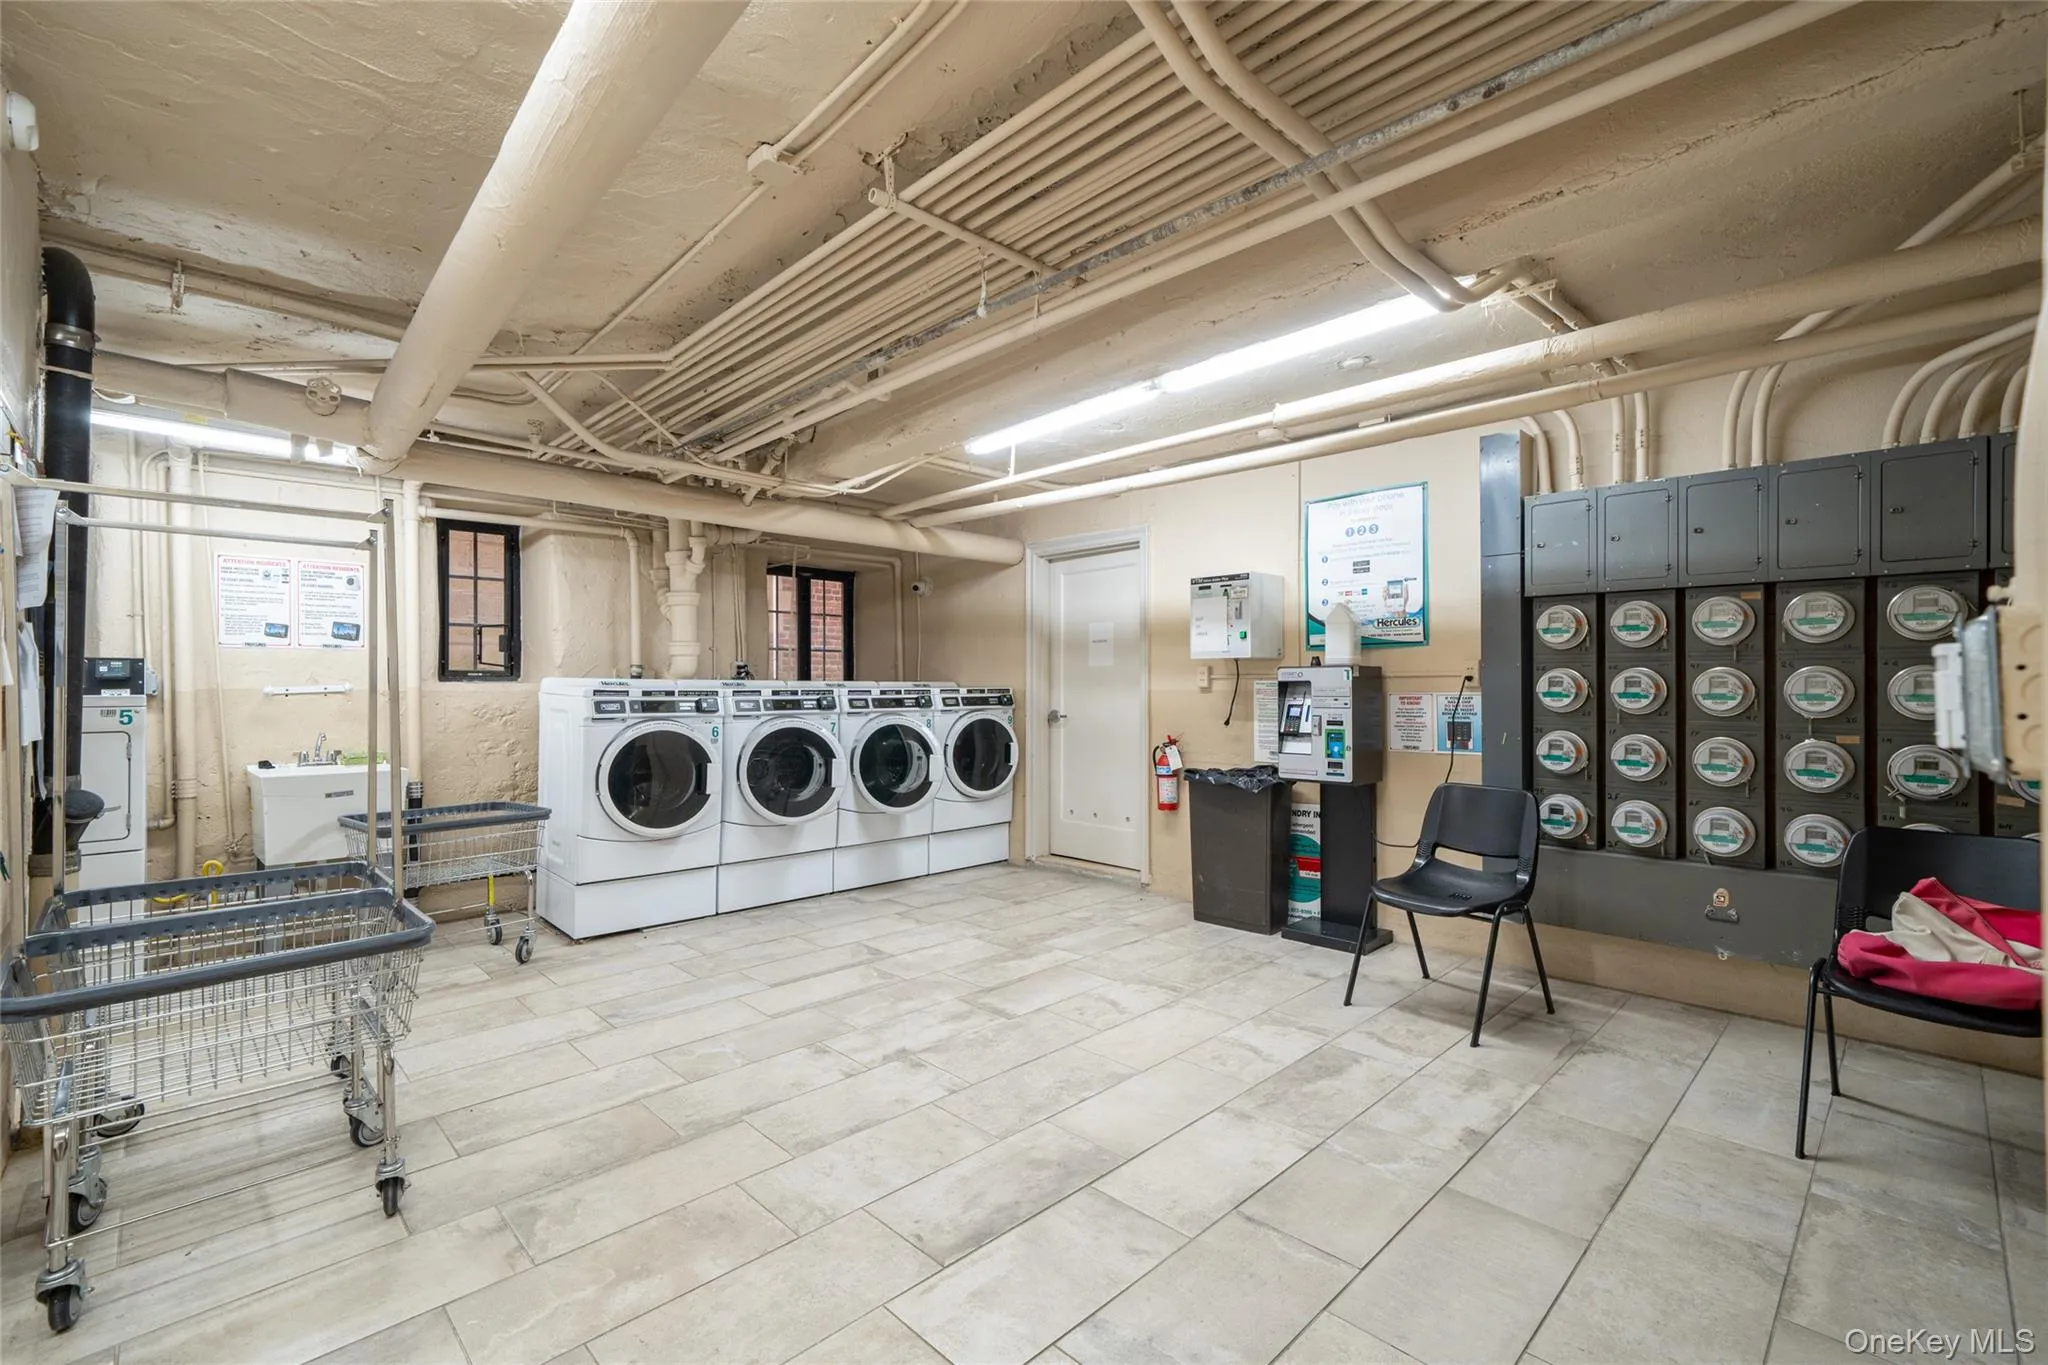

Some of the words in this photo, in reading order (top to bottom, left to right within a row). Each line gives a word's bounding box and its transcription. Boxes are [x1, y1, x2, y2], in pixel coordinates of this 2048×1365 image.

[1377, 617, 1417, 627] Hercules
[118, 709, 133, 726] 5
[1007, 715, 1013, 724] 9
[830, 722, 836, 732] 7
[926, 719, 932, 728] 8
[711, 726, 719, 738] 6
